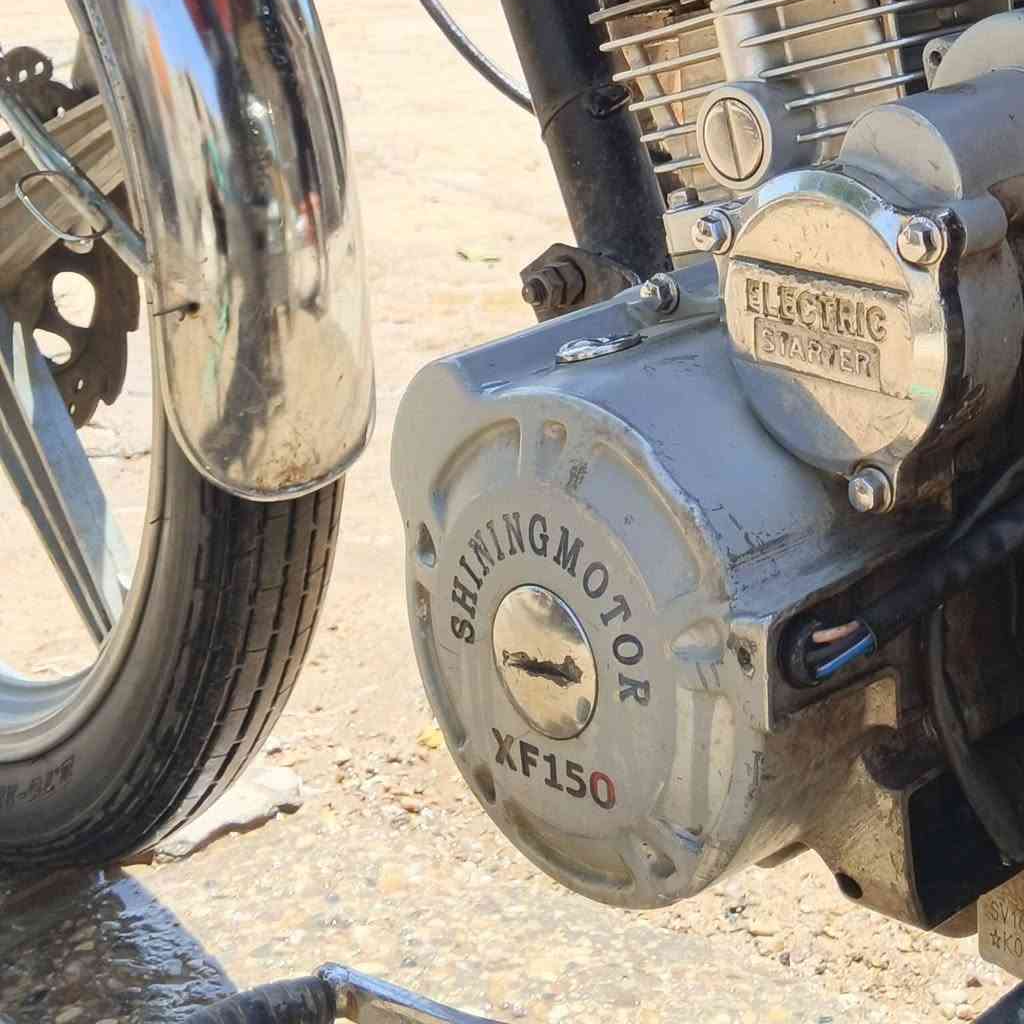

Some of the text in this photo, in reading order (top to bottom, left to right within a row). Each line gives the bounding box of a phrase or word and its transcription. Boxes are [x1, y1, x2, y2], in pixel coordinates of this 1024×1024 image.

[744, 278, 887, 343] ELECTRIC
[759, 327, 872, 377] STARTER
[492, 727, 616, 810] XF150
